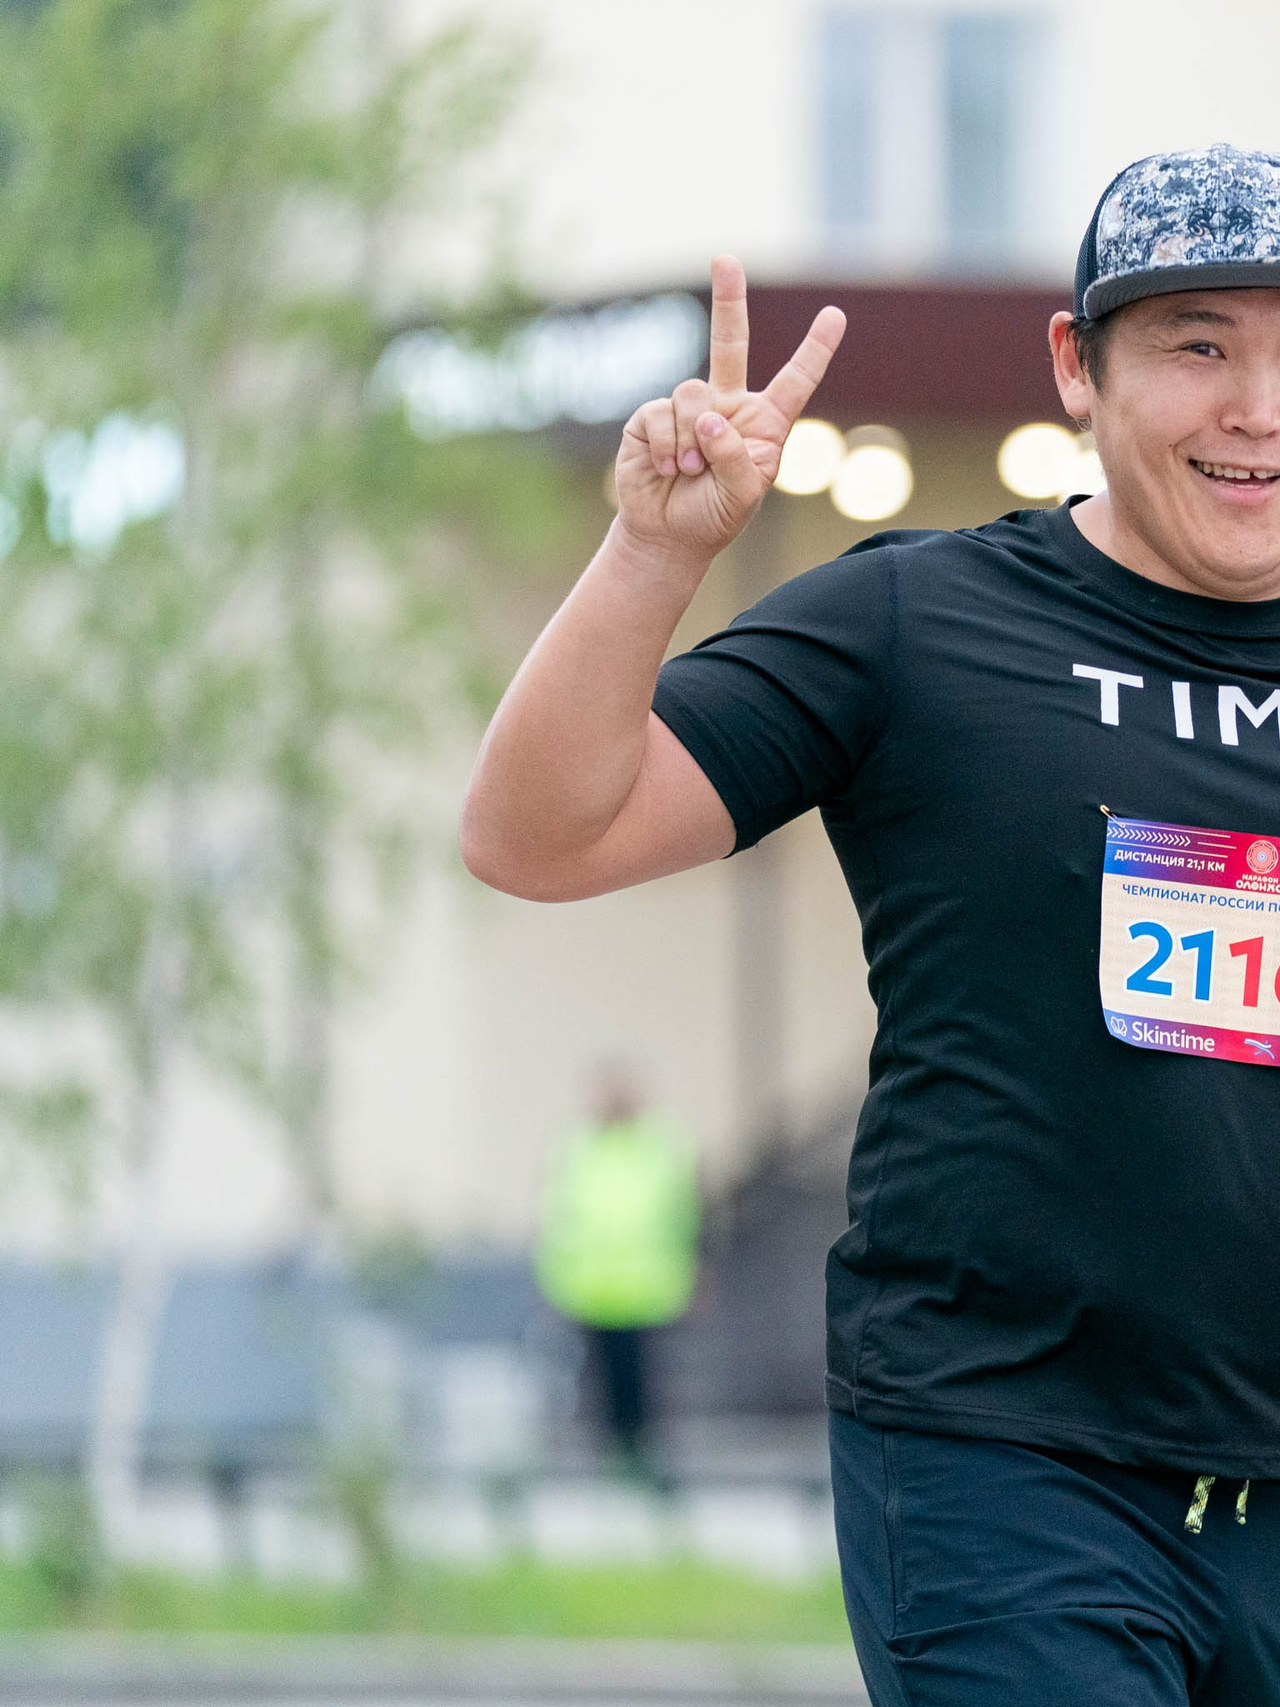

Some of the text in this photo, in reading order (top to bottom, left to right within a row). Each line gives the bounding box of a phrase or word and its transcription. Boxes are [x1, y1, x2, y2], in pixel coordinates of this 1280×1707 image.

[1114, 849, 1225, 872] ДИСТАНЦИЯ 21,1 КМ
[1242, 874, 1279, 884] МАРАФОН
[1122, 884, 1206, 905] ЧЕМПИОНАТ
[1209, 895, 1264, 911] РОССИИ
[1131, 1021, 1215, 1053] Skintime
